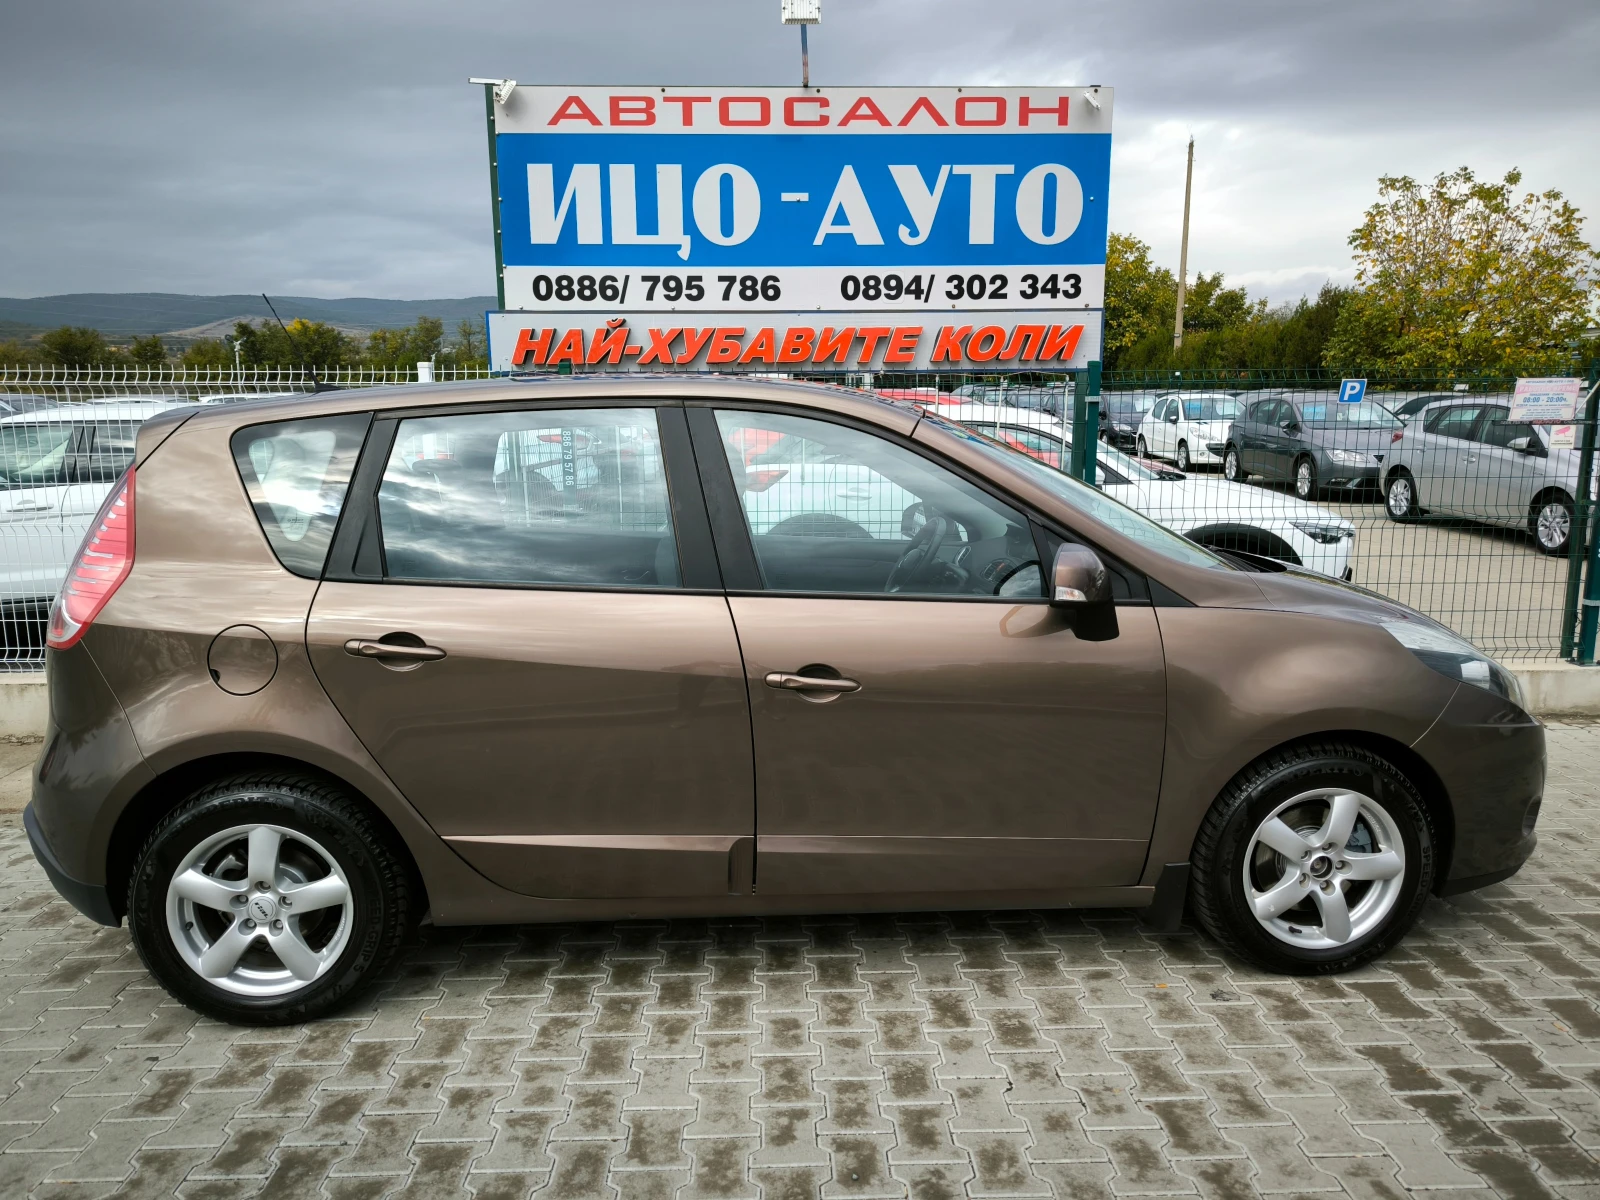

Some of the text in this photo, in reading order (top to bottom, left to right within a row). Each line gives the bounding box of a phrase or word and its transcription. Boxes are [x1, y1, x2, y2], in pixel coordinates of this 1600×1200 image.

[547, 95, 1069, 127] АВТОСАЛОН
[532, 273, 1082, 304] 0886/ 795 786 0894/ 302 343
[511, 318, 1086, 366] НАЙ-ХУБАВИТЕ КОЛИ
[1343, 382, 1361, 400] P
[563, 431, 574, 486] 886 79 57 86
